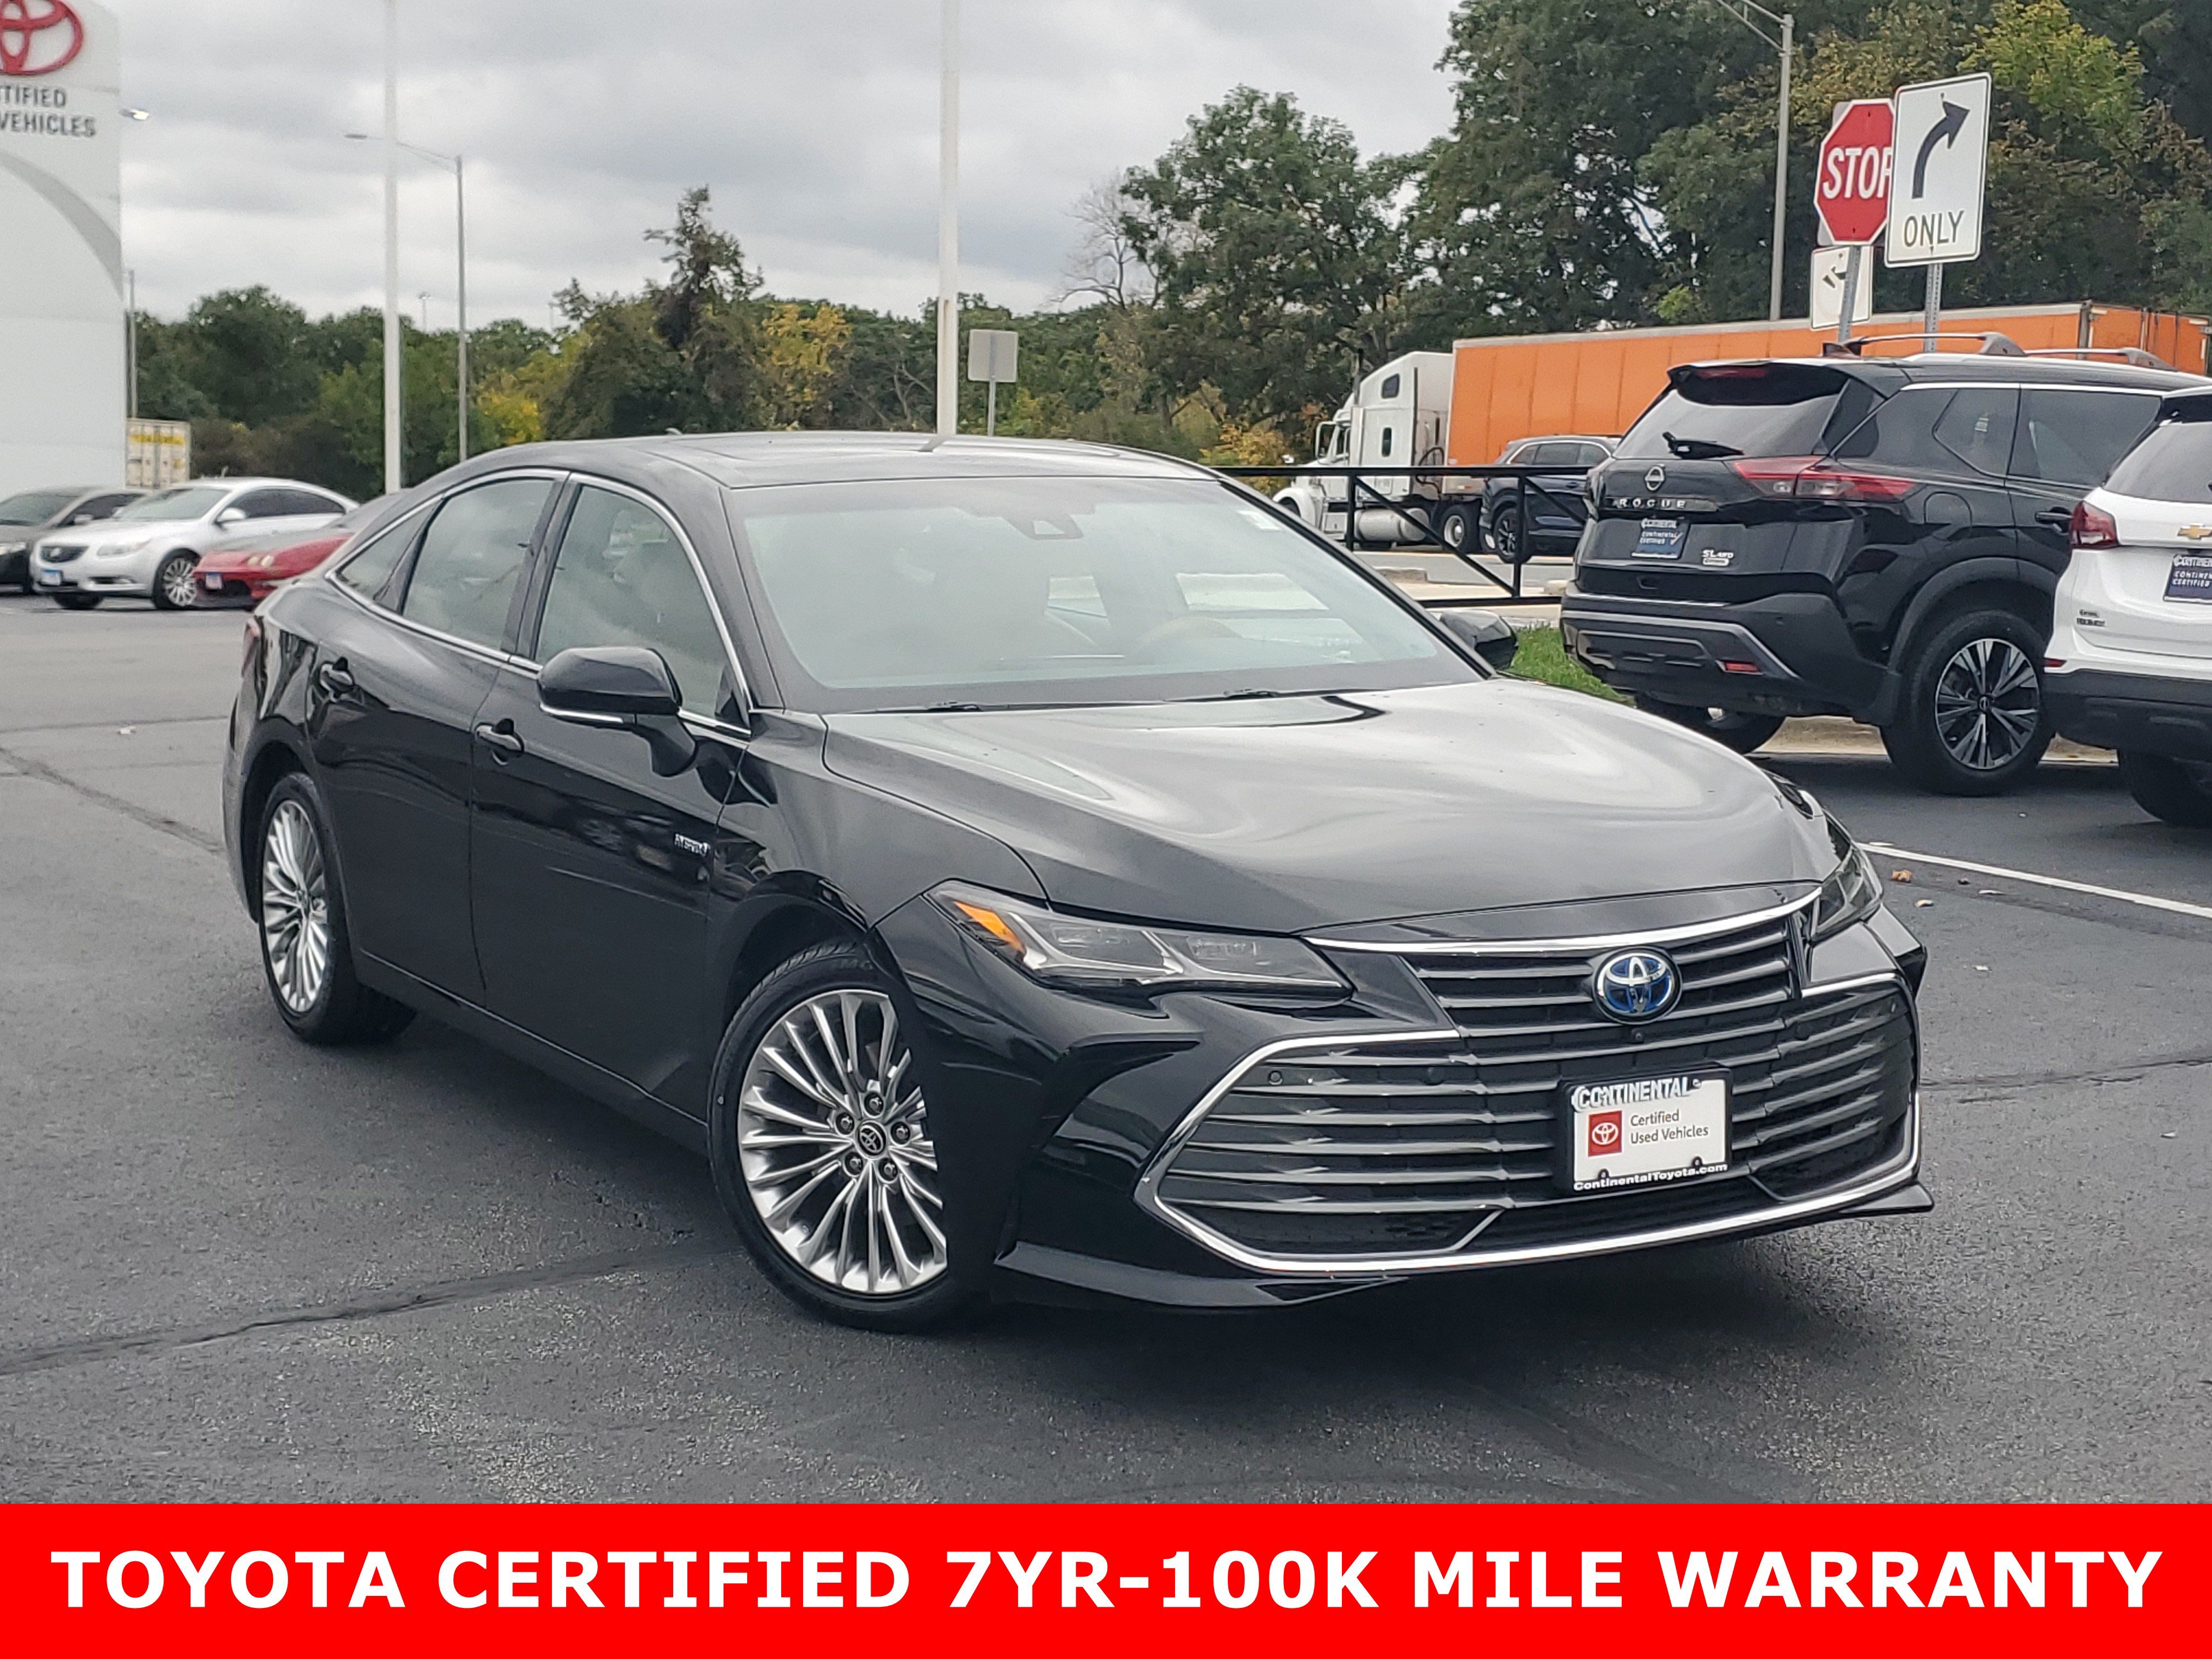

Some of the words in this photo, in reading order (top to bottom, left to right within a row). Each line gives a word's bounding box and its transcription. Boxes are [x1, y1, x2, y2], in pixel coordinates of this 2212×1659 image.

[0, 84, 67, 108] TIFIED
[1903, 210, 1965, 248] ONLY
[1617, 498, 1686, 509] ROGUE
[1571, 1076, 1690, 1113] CONTINENTAL
[1630, 1109, 1679, 1126] Certified
[1630, 1130, 1658, 1144] Used
[1661, 1125, 1709, 1141] Vehicles
[1573, 1164, 1728, 1191] ContinentalToyota.com
